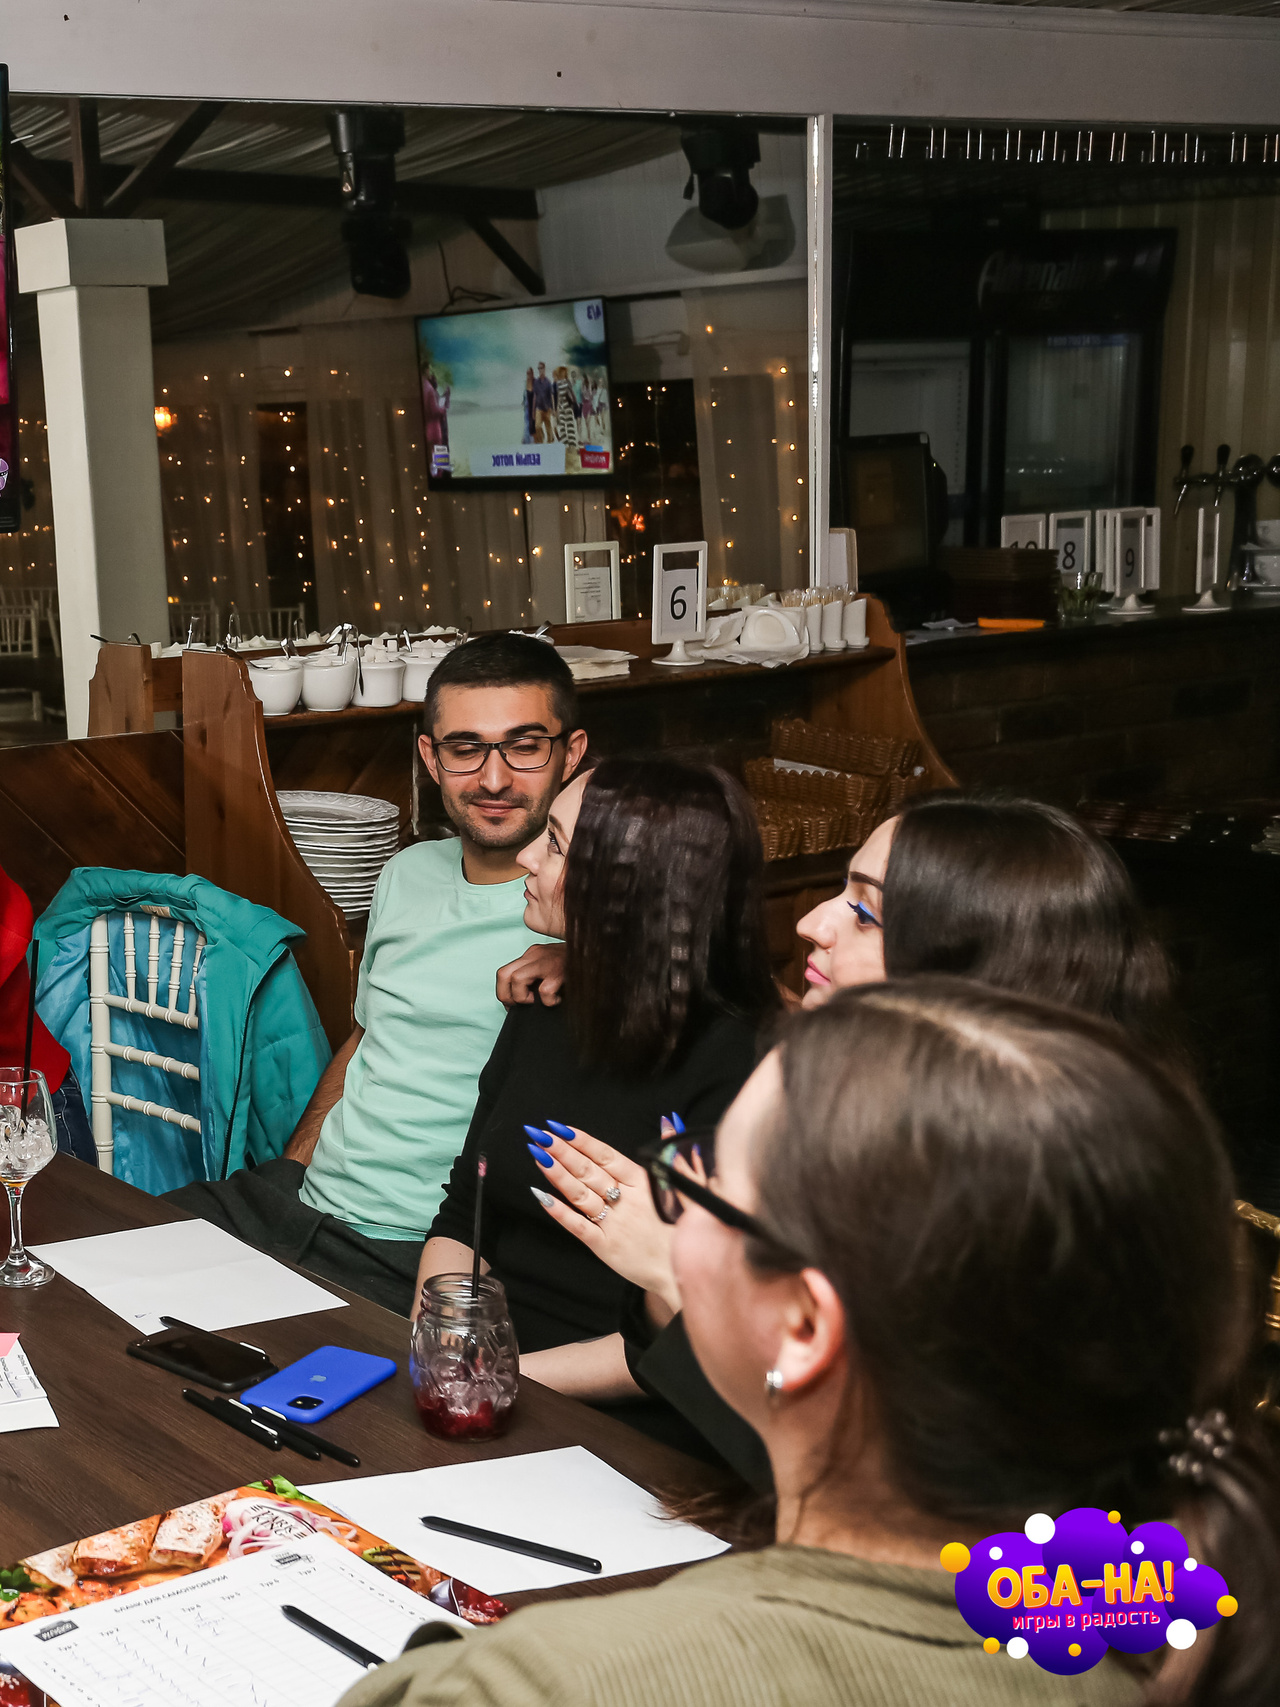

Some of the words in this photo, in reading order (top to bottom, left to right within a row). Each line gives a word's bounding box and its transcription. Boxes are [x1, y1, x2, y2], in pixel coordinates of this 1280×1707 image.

[1062, 541, 1075, 570] 8
[1125, 548, 1135, 578] 9
[670, 585, 687, 620] 6
